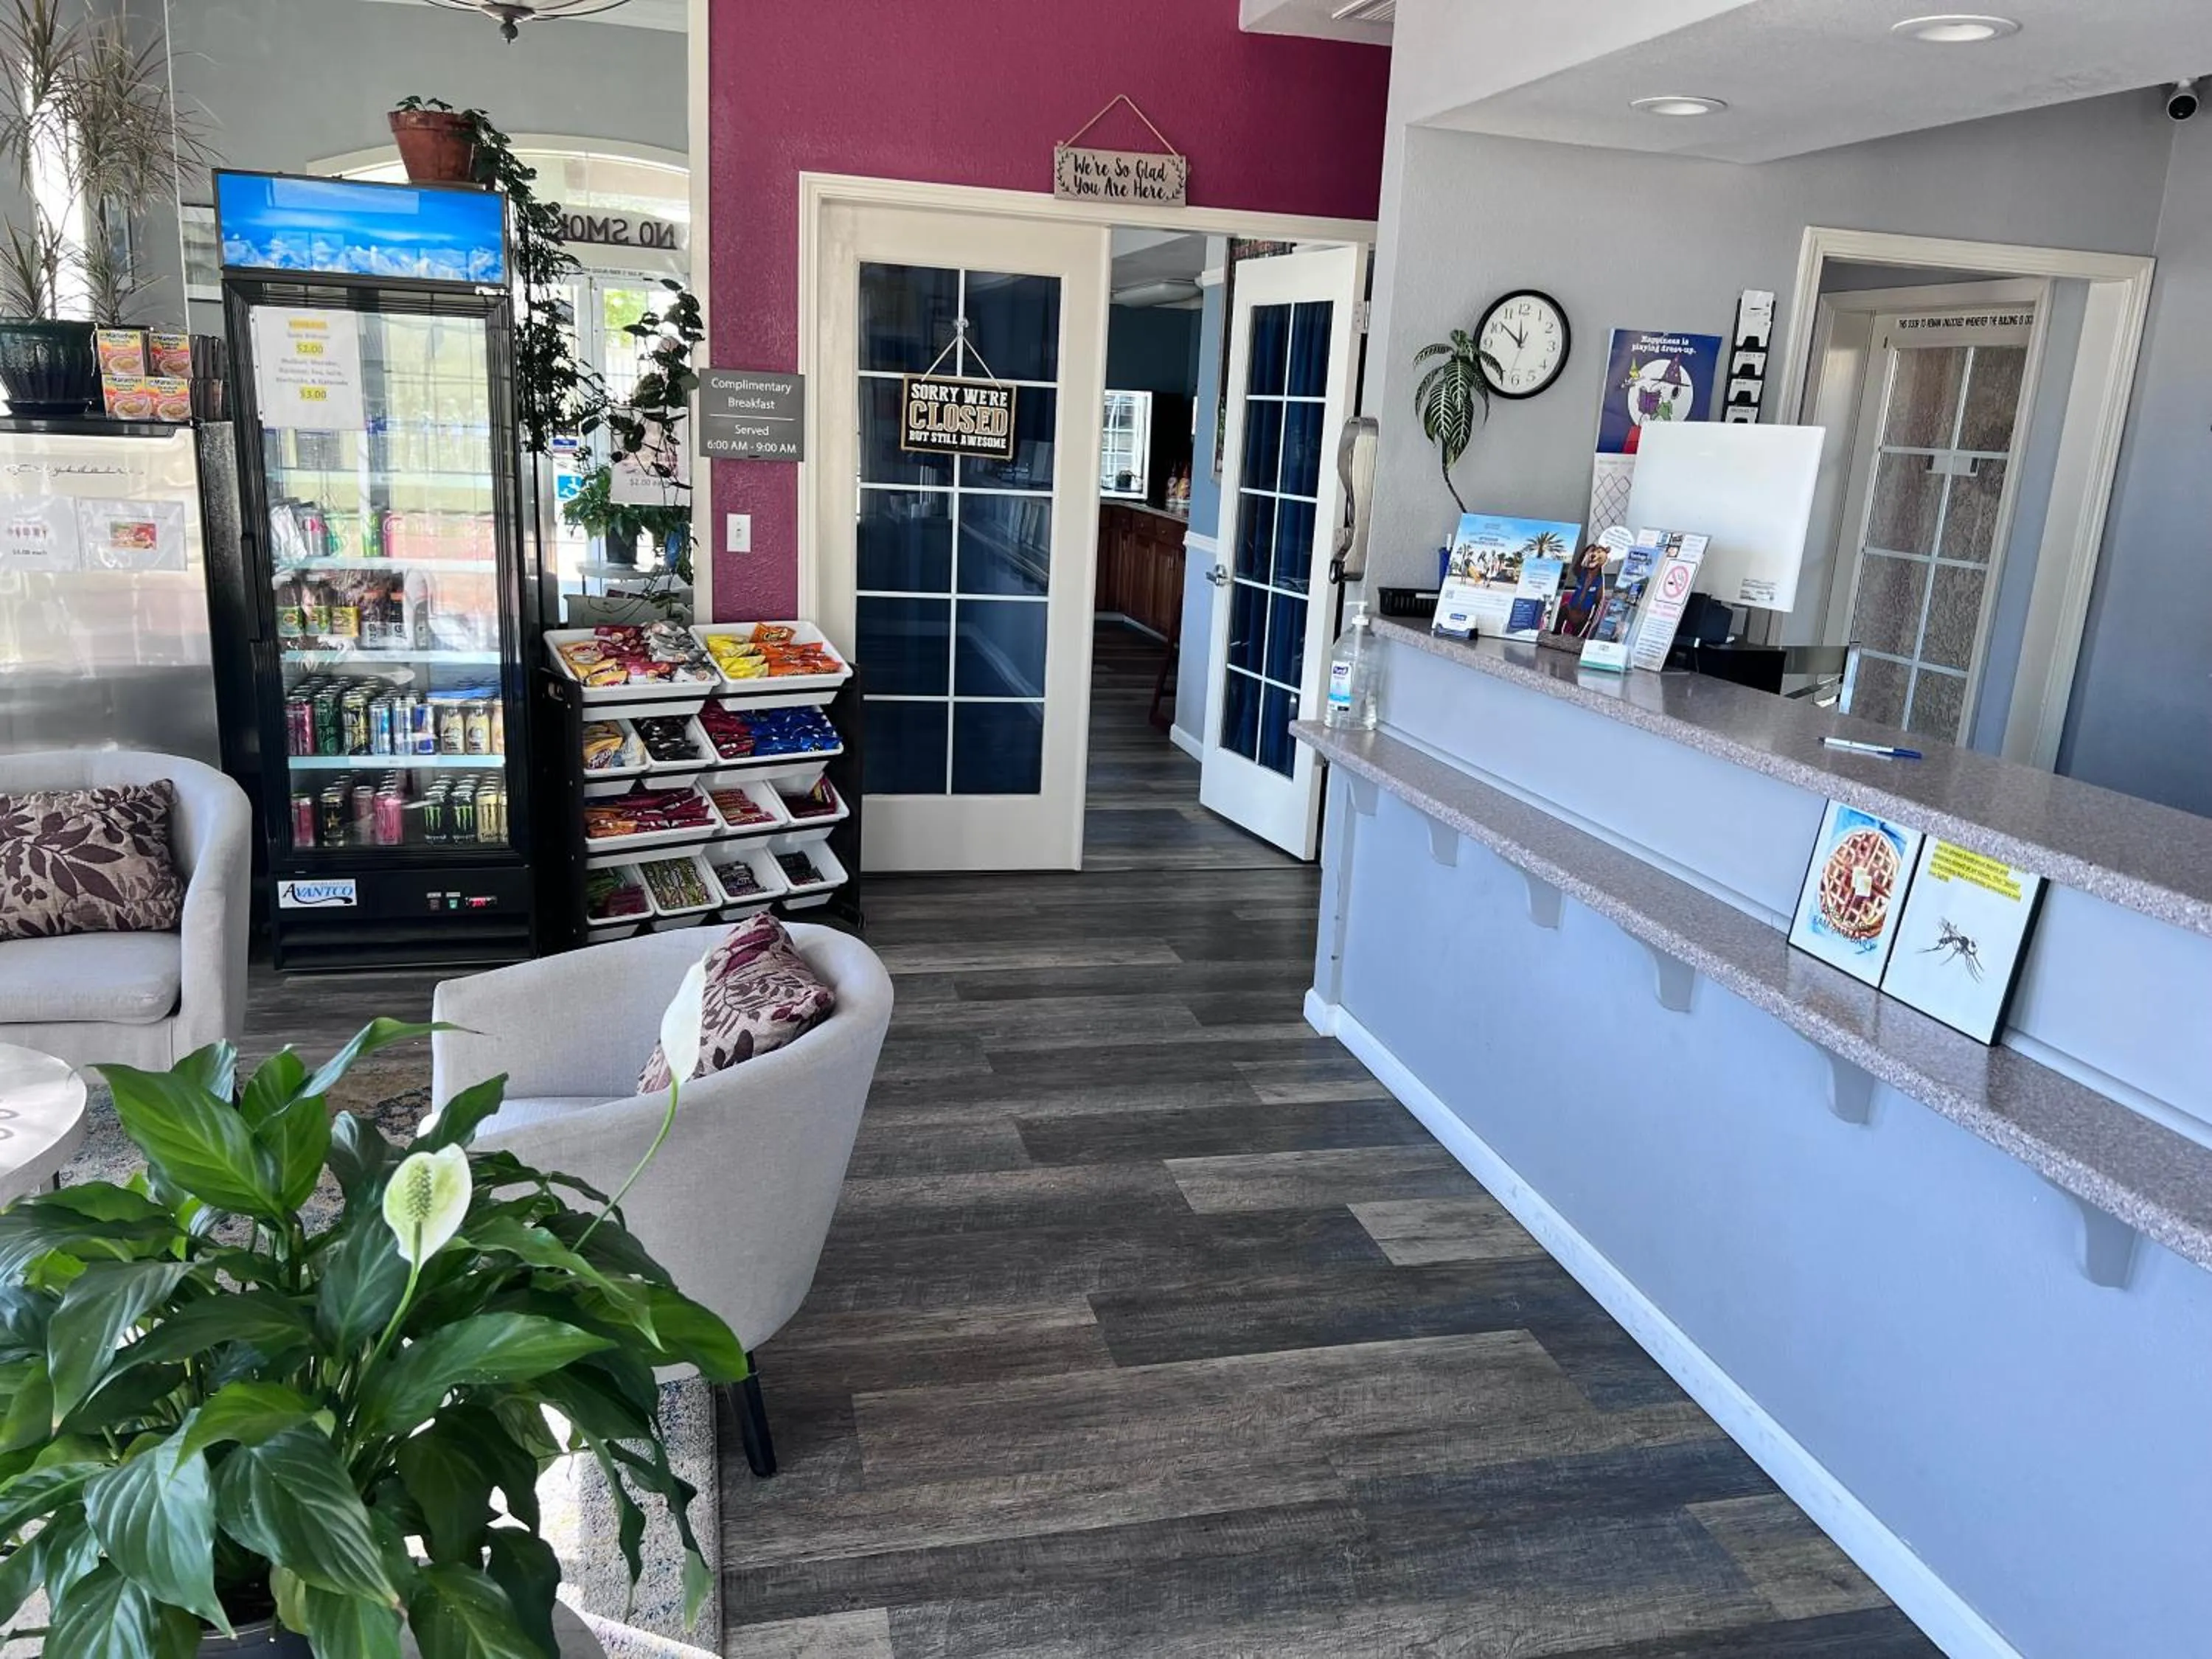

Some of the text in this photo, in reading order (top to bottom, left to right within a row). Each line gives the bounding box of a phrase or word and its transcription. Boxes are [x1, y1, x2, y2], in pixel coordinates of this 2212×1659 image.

[1074, 154, 1167, 182] We're So Glad
[1074, 175, 1100, 195] You
[1104, 177, 1129, 197] Are
[1504, 307, 1513, 319] 11
[1519, 303, 1531, 316] 12
[1537, 309, 1542, 321] 1
[1545, 321, 1554, 334] 2
[1484, 338, 1493, 349] 9
[1547, 341, 1556, 352] 3
[1539, 359, 1547, 370] 4
[1511, 370, 1520, 386] 6
[1526, 370, 1536, 382] 5
[711, 377, 792, 394] Complimentary
[911, 383, 1008, 406] SORRY WE'RE
[728, 397, 775, 409] Breakfast
[909, 399, 1009, 437] CLOSED
[734, 425, 770, 436] Served
[909, 430, 1006, 449] BUT STILL AWESOME
[707, 440, 728, 450] 6:00
[731, 441, 748, 451] AM
[756, 442, 777, 452] 9:00
[779, 443, 797, 453] AM
[282, 883, 353, 905] AVANTCO
